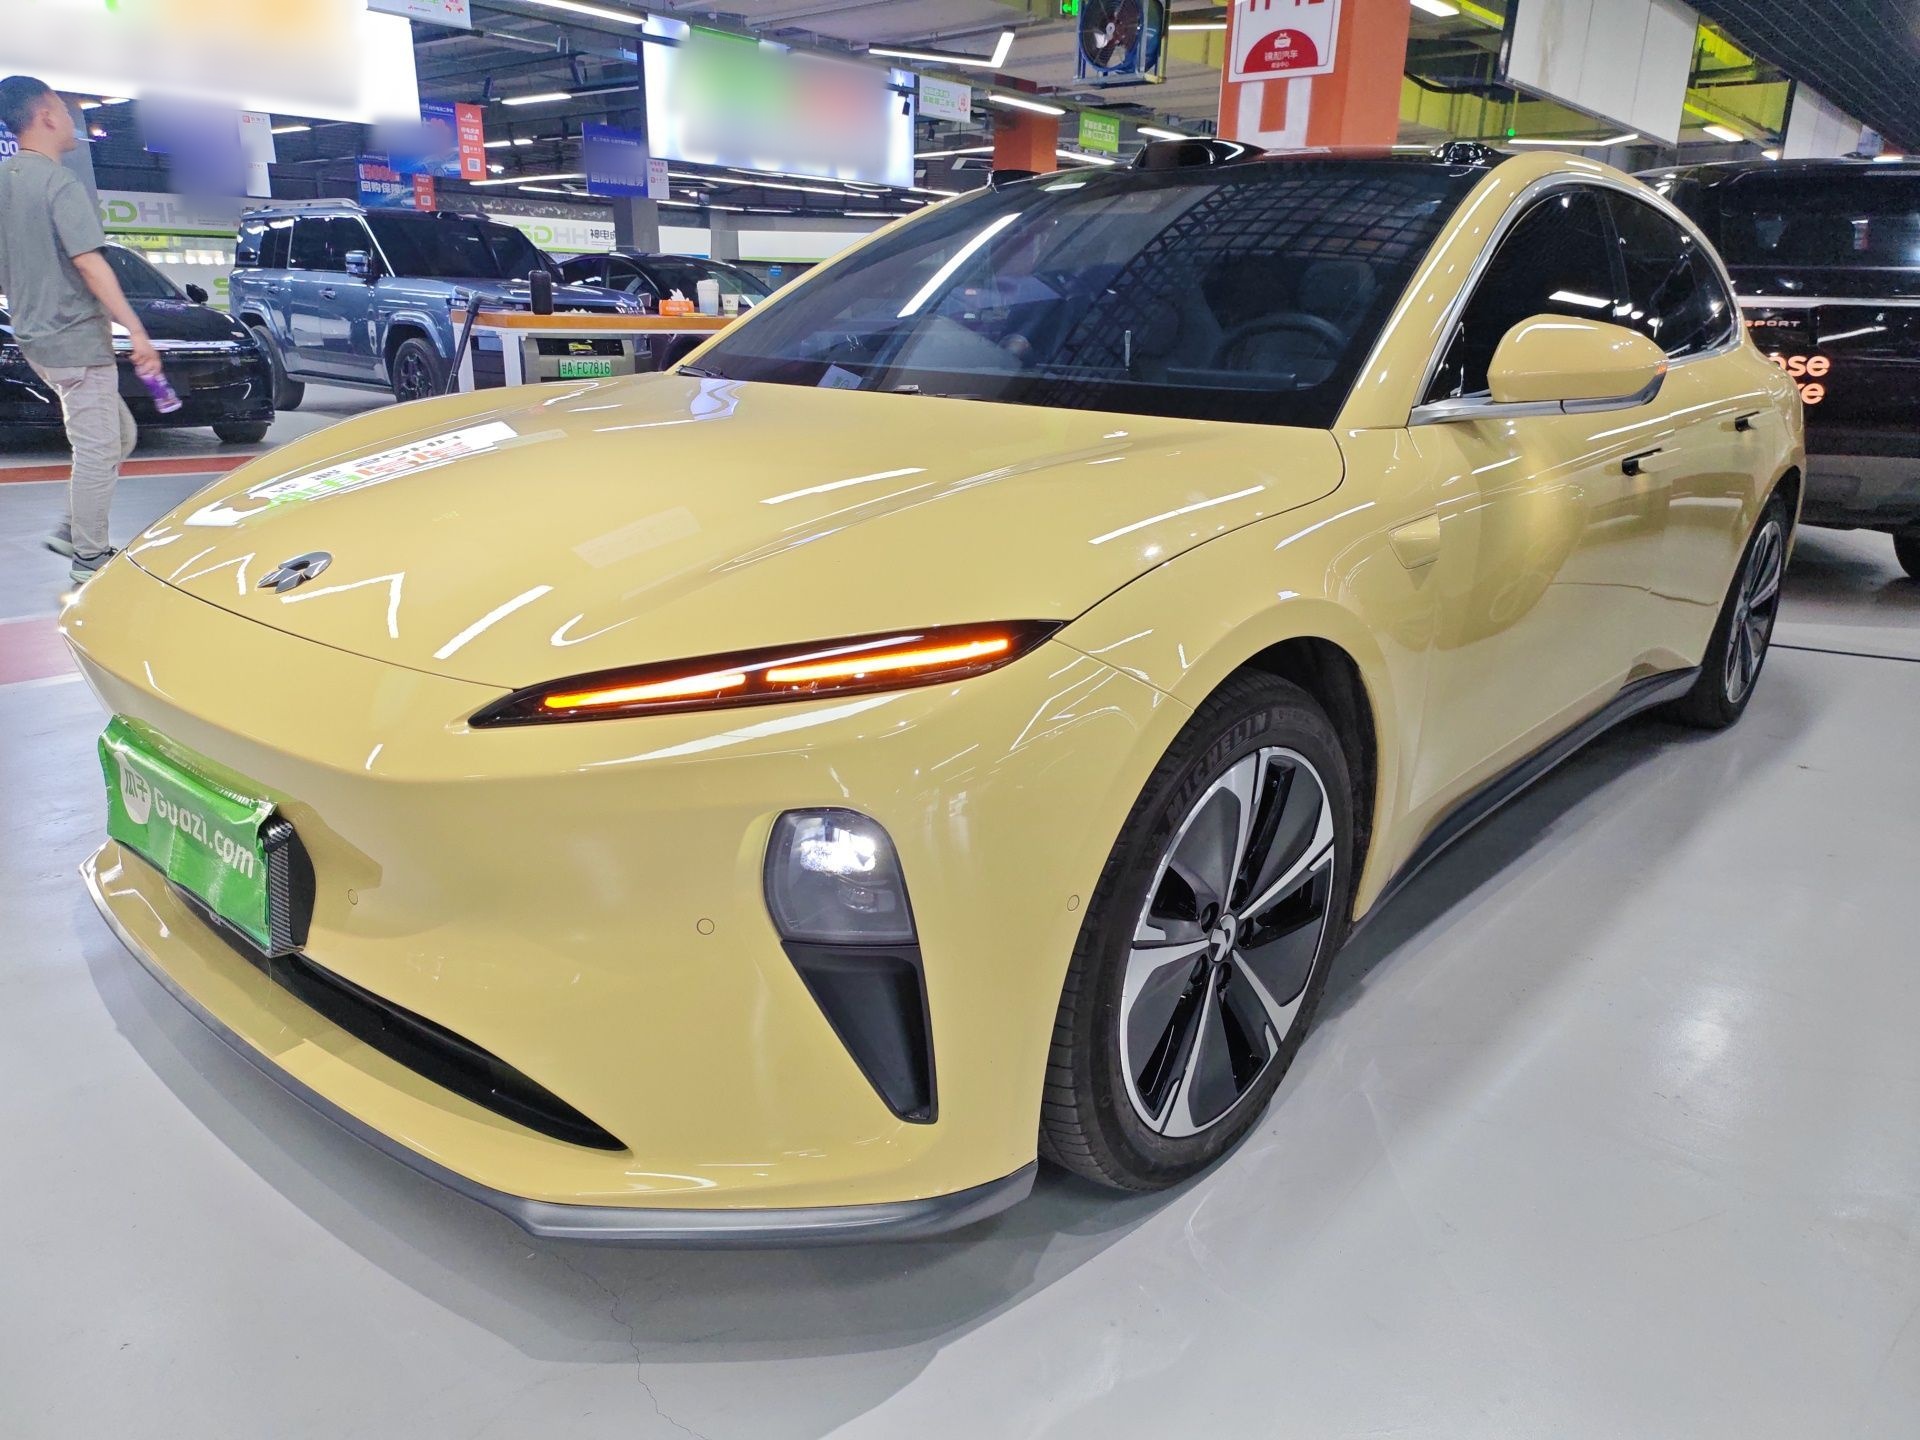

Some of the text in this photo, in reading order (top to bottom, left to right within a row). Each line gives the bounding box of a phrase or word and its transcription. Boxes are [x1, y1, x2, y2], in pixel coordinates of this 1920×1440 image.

[124, 767, 149, 804] 瓜子
[1166, 711, 1267, 826] MICHELIN
[153, 786, 254, 879] Guazi.com
